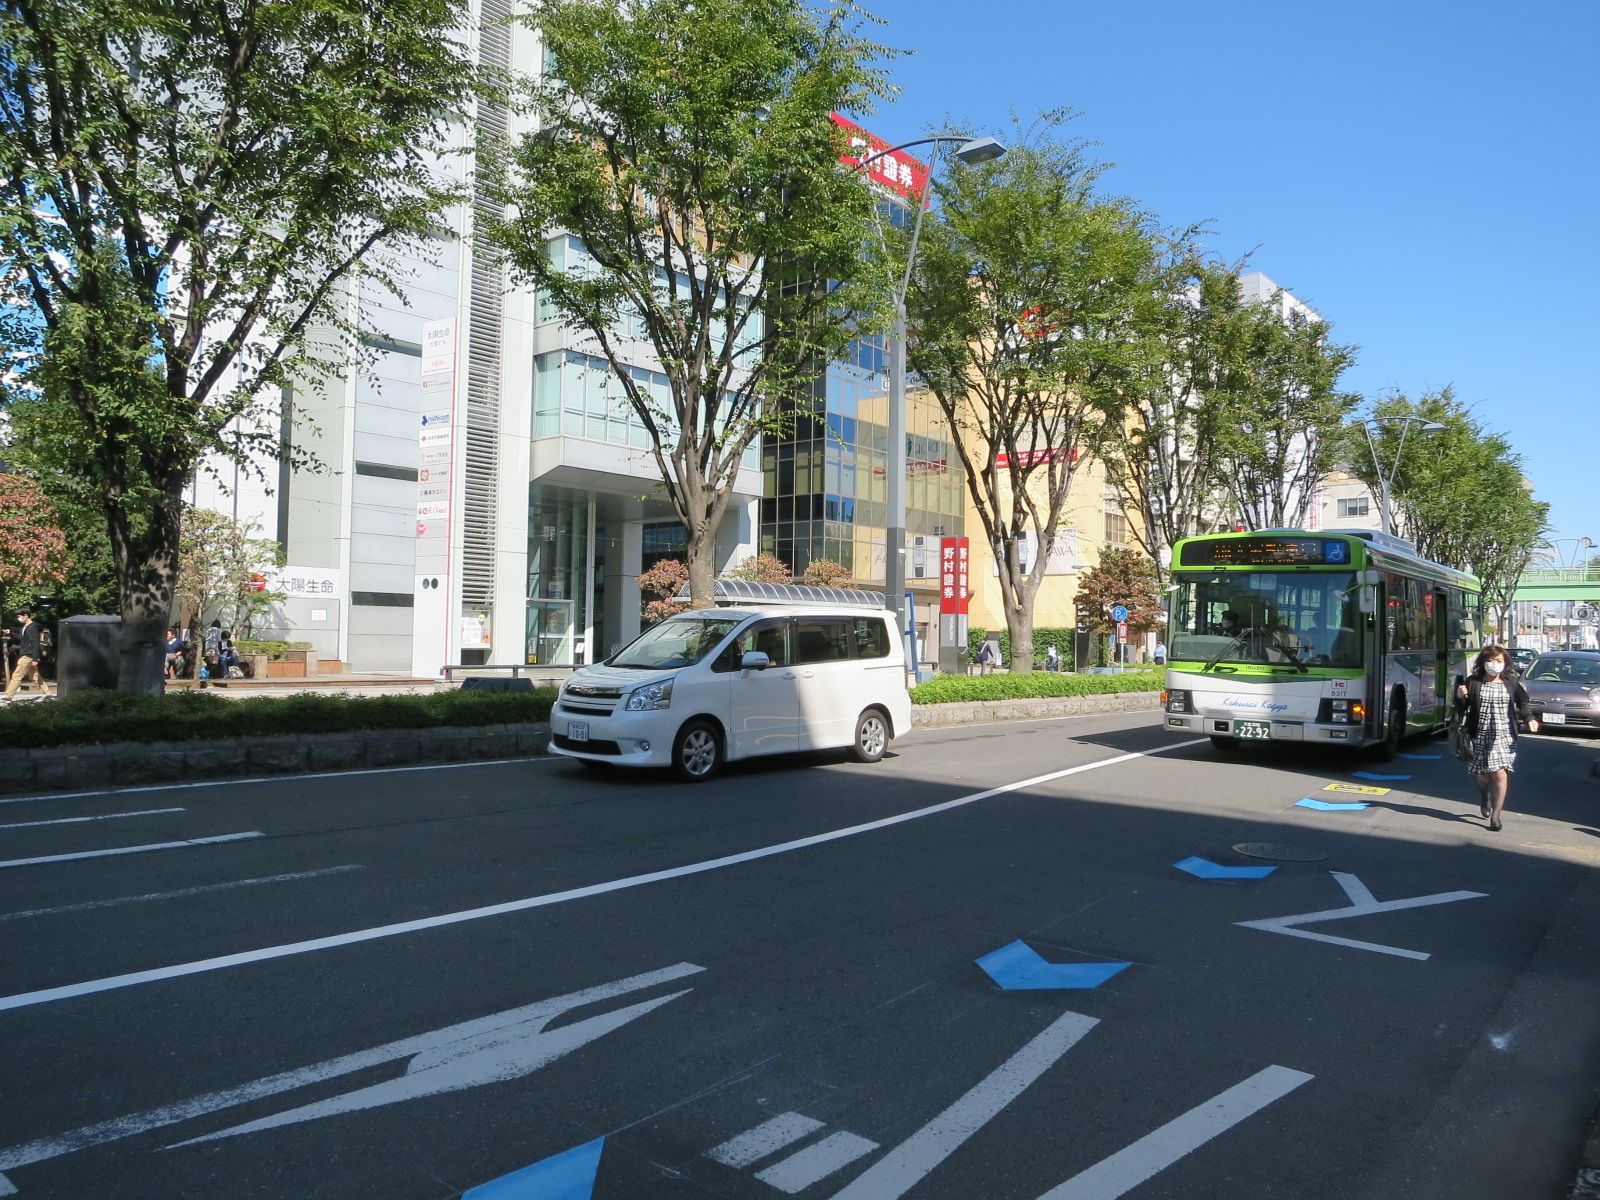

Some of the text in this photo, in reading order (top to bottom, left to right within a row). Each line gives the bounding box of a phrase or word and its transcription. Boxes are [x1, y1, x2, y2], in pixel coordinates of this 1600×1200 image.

[274, 577, 335, 595] 太陽生命
[943, 547, 955, 599] 野村證券
[959, 547, 968, 599] 野村證券
[1261, 698, 1289, 713] Kogyo
